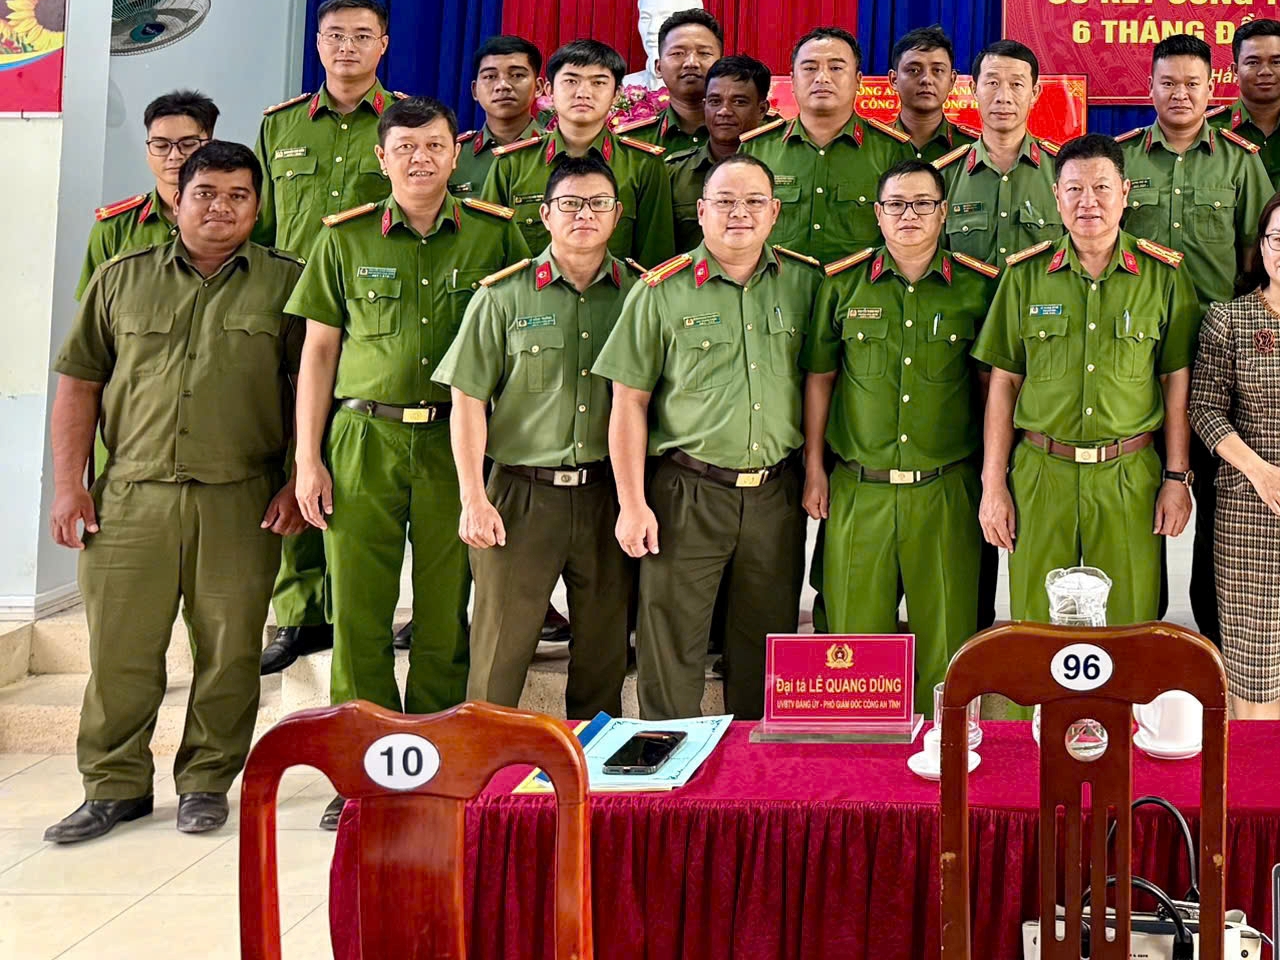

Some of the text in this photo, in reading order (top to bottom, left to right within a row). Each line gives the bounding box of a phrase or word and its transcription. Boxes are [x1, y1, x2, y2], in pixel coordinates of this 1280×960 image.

[1072, 20, 1091, 44] 6
[1063, 654, 1100, 680] 96
[776, 675, 901, 695] Đại tá LÊ QUANG DŨNG
[380, 746, 423, 776] 10
